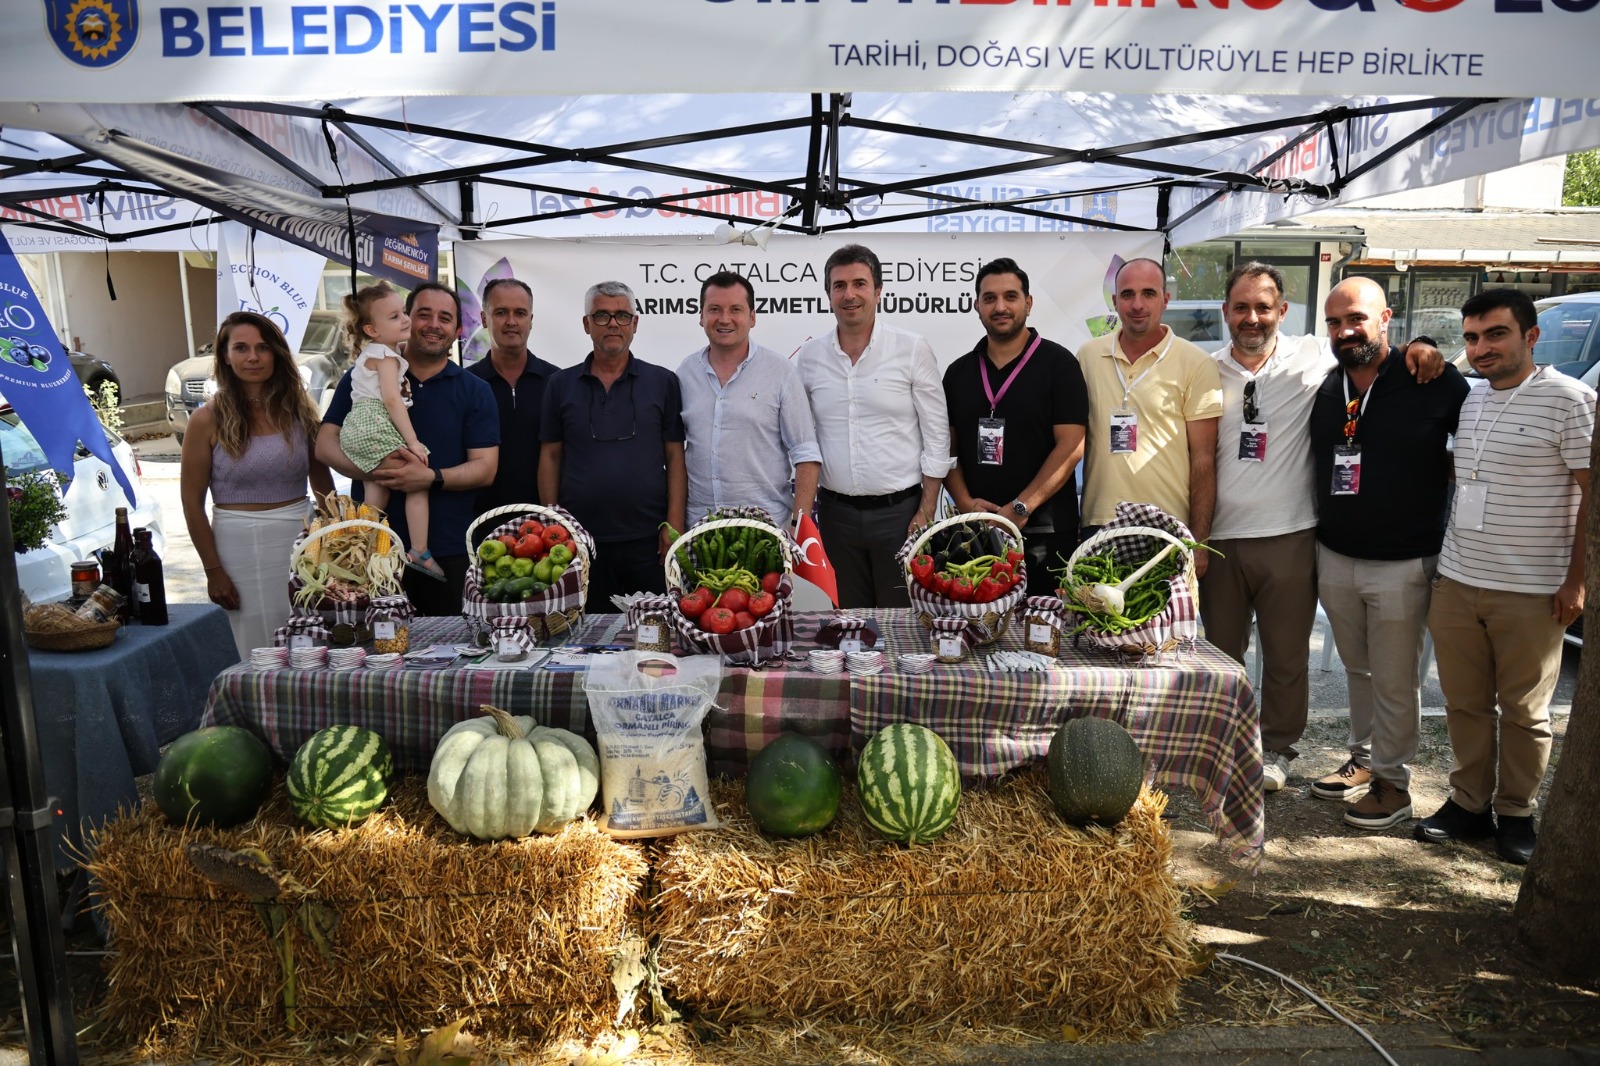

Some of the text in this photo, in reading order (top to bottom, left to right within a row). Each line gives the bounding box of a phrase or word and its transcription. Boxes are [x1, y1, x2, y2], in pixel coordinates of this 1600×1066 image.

[161, 1, 556, 58] BELEDİYESİ
[828, 40, 1484, 76] TARİHİ, DOĞASI VE KÜLTÜRÜYLE HEP BİRLİKTE
[384, 252, 403, 266] TARIM
[639, 263, 685, 284] T.C.
